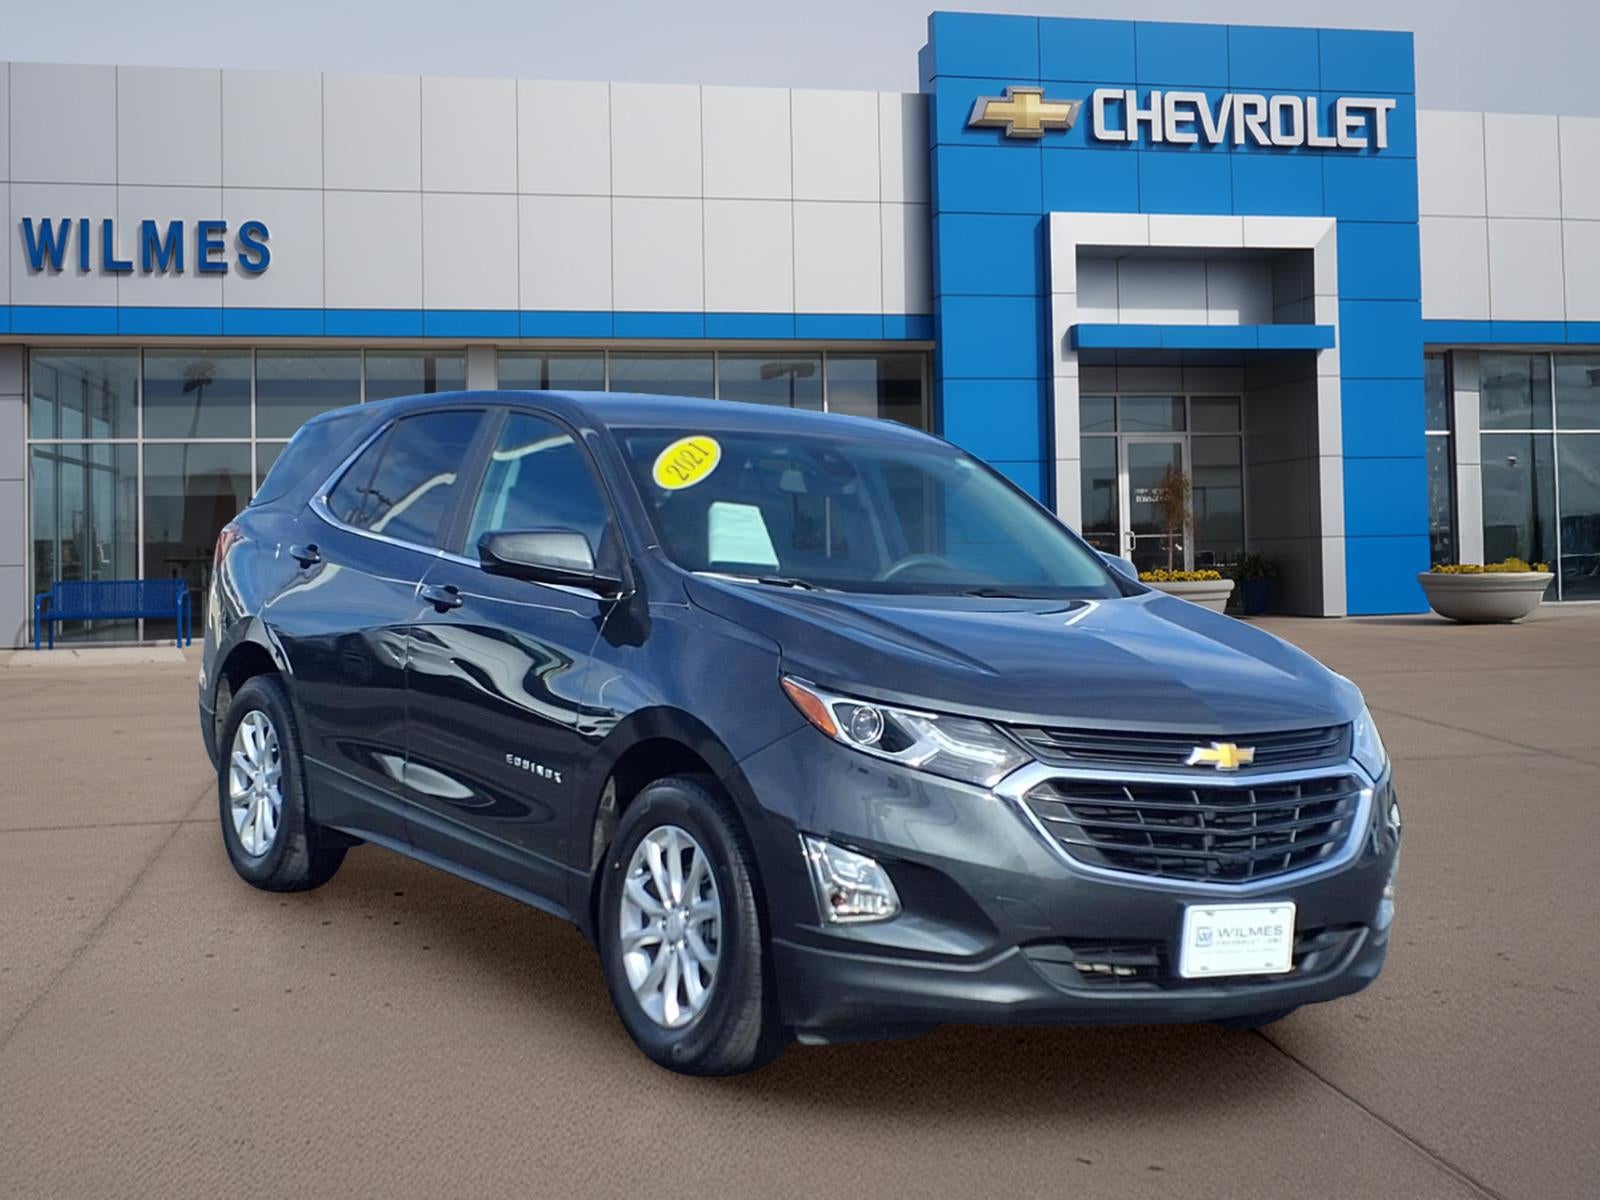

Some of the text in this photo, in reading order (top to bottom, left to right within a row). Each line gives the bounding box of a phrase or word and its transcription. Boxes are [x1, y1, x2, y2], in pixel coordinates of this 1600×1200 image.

[1092, 88, 1396, 149] CHEVROLET
[22, 217, 271, 273] WILMES
[665, 442, 710, 481] 2021
[1216, 924, 1284, 938] WILMES
